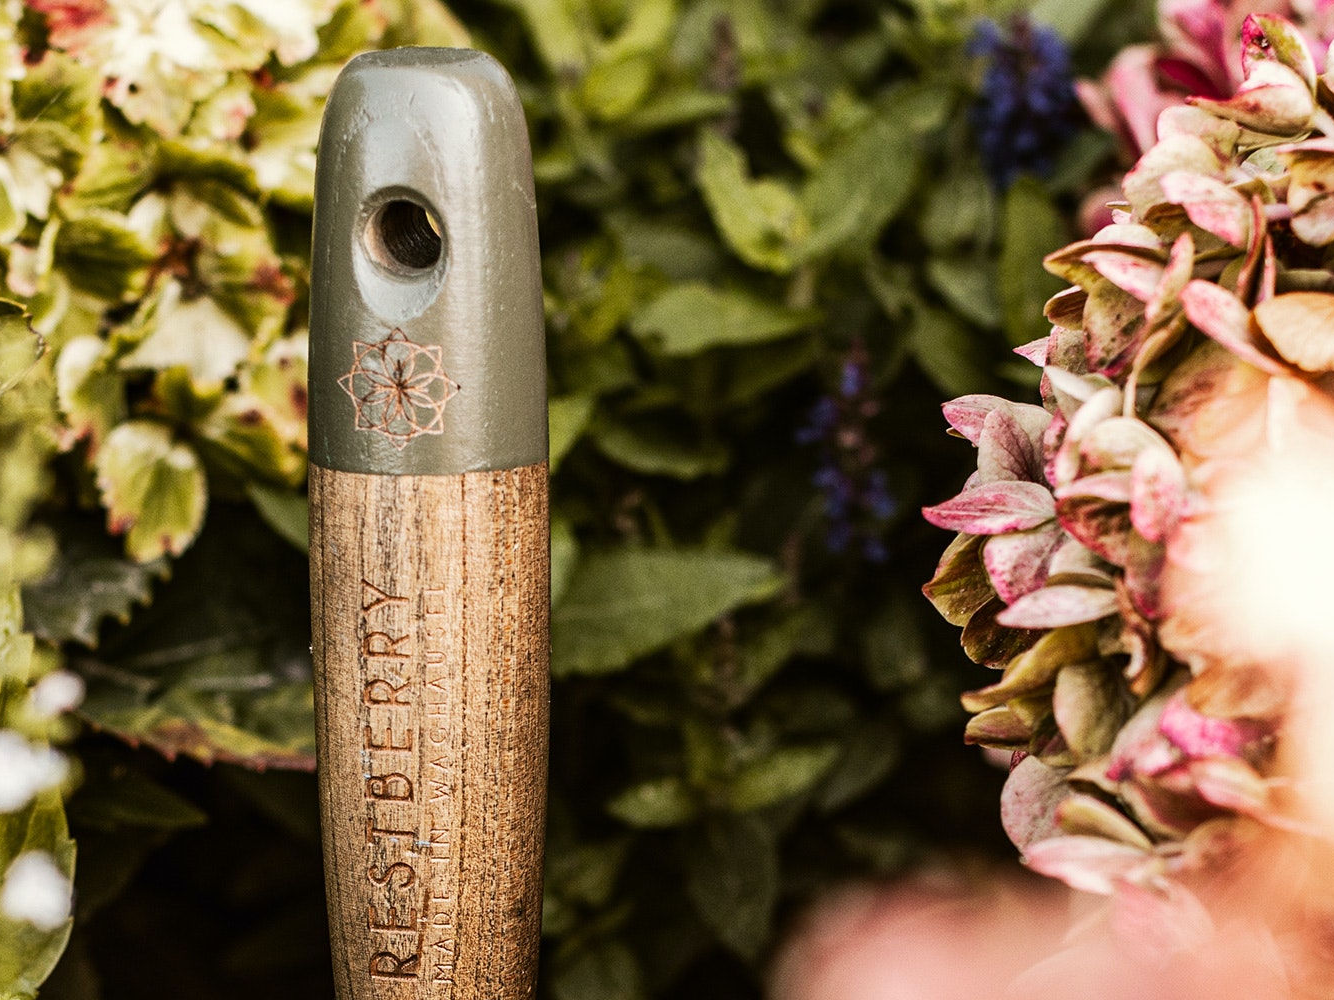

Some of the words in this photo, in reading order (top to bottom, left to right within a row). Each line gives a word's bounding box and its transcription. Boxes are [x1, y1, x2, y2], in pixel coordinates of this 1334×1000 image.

[361, 578, 420, 983] RESTBERRY
[429, 827, 452, 863] IN
[429, 890, 454, 984] MADE
